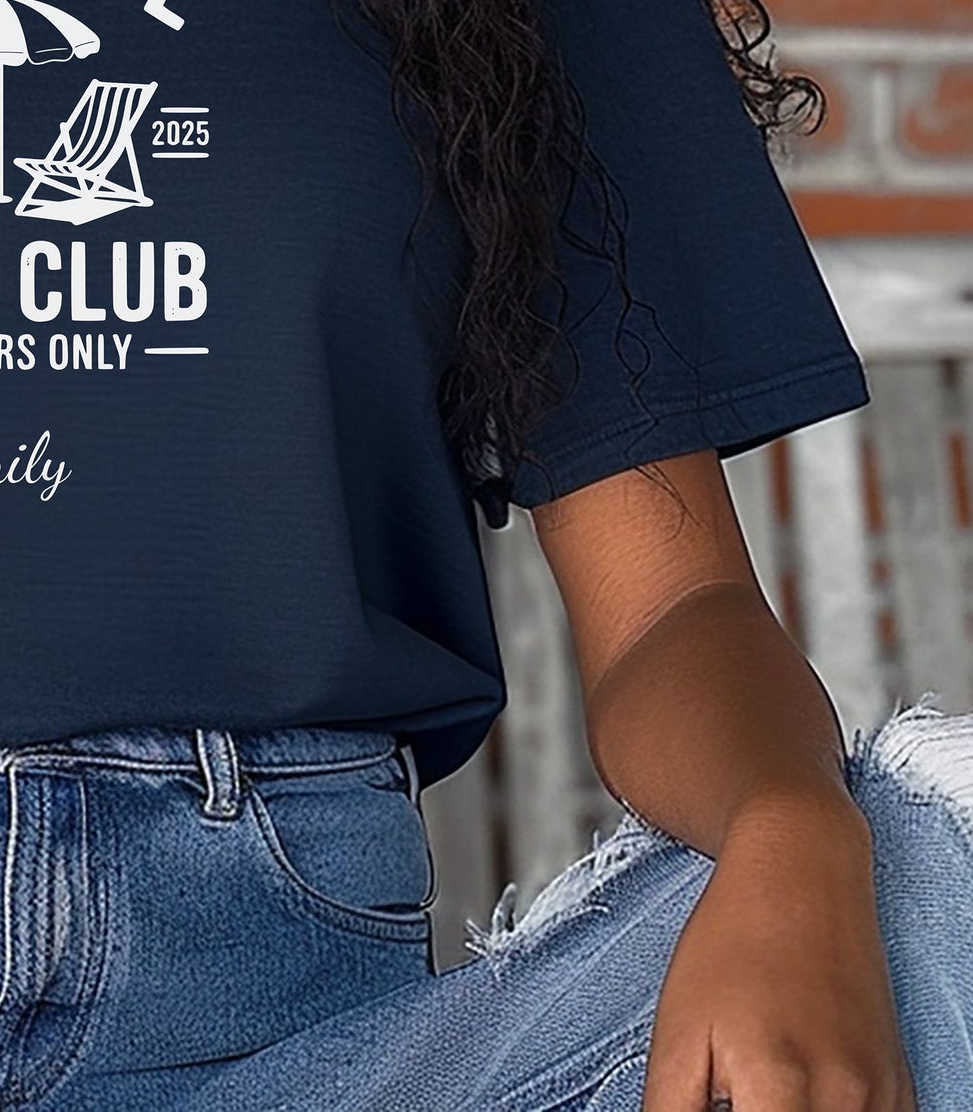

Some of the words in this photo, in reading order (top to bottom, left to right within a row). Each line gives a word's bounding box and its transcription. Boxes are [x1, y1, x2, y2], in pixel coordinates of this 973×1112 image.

[151, 120, 210, 146] 2025
[19, 240, 208, 322] CLUB
[49, 333, 133, 370] ONLY
